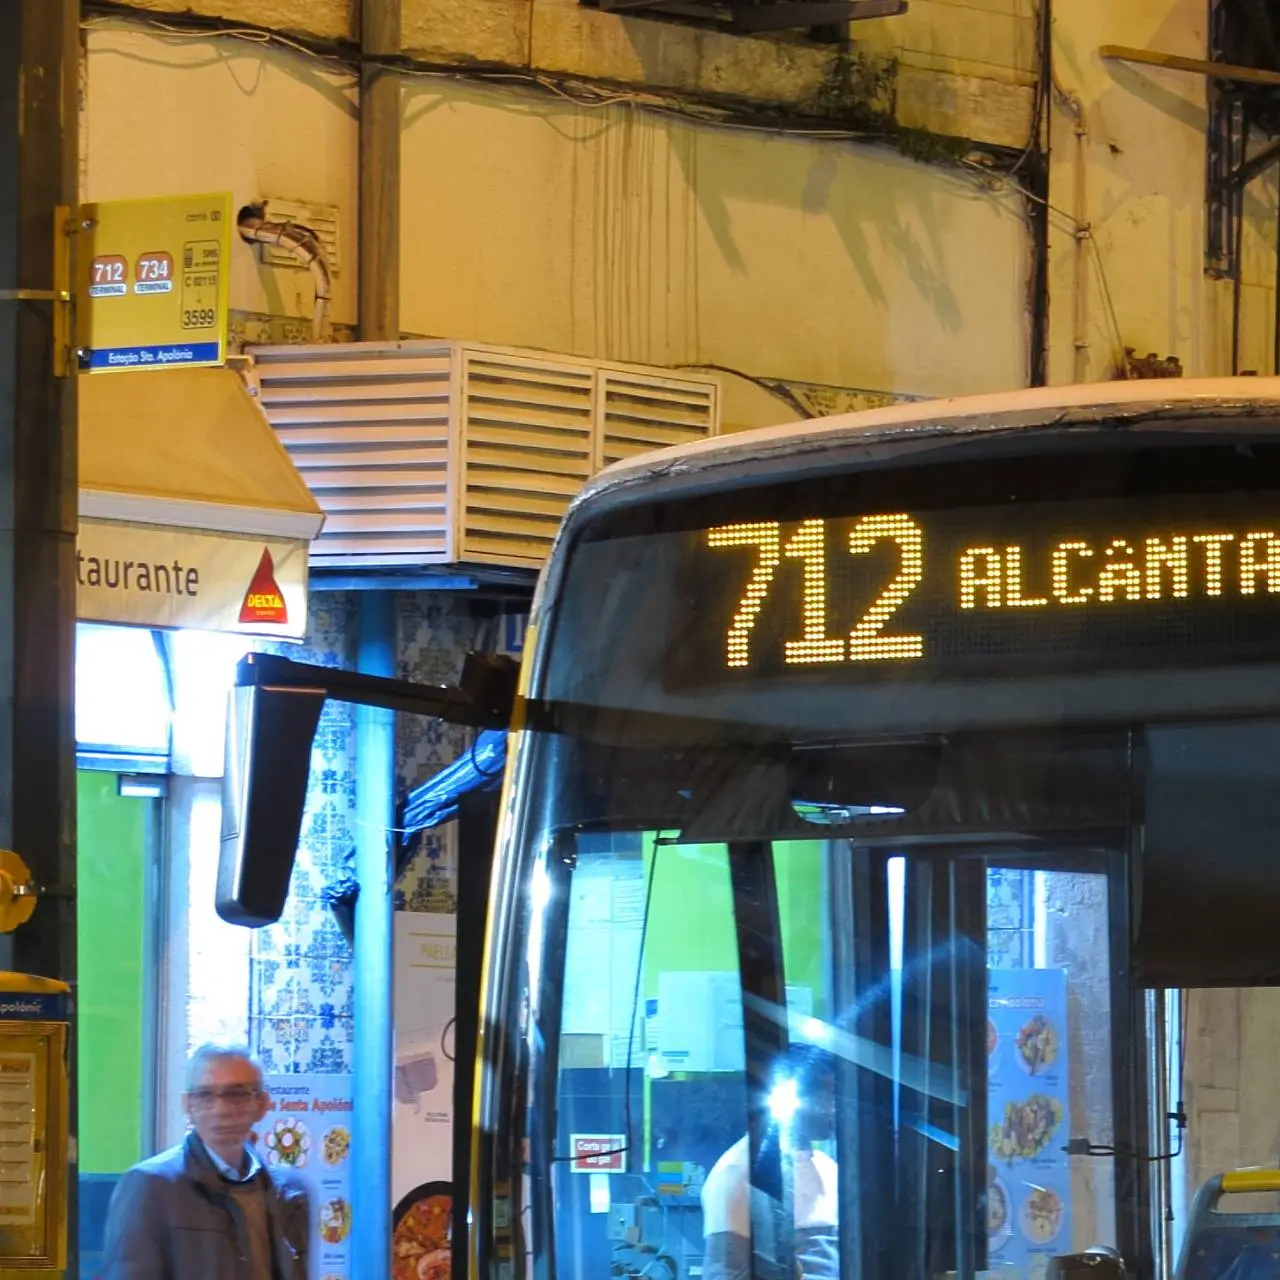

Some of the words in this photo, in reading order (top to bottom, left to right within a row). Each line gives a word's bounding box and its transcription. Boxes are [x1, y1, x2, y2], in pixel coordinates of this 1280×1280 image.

[94, 262, 124, 282] 712
[140, 259, 169, 279] 734
[183, 309, 215, 326] 3599
[108, 352, 138, 364] Estação
[157, 348, 193, 361] Apolónia
[705, 511, 925, 668] 712
[247, 594, 282, 608] DELTA
